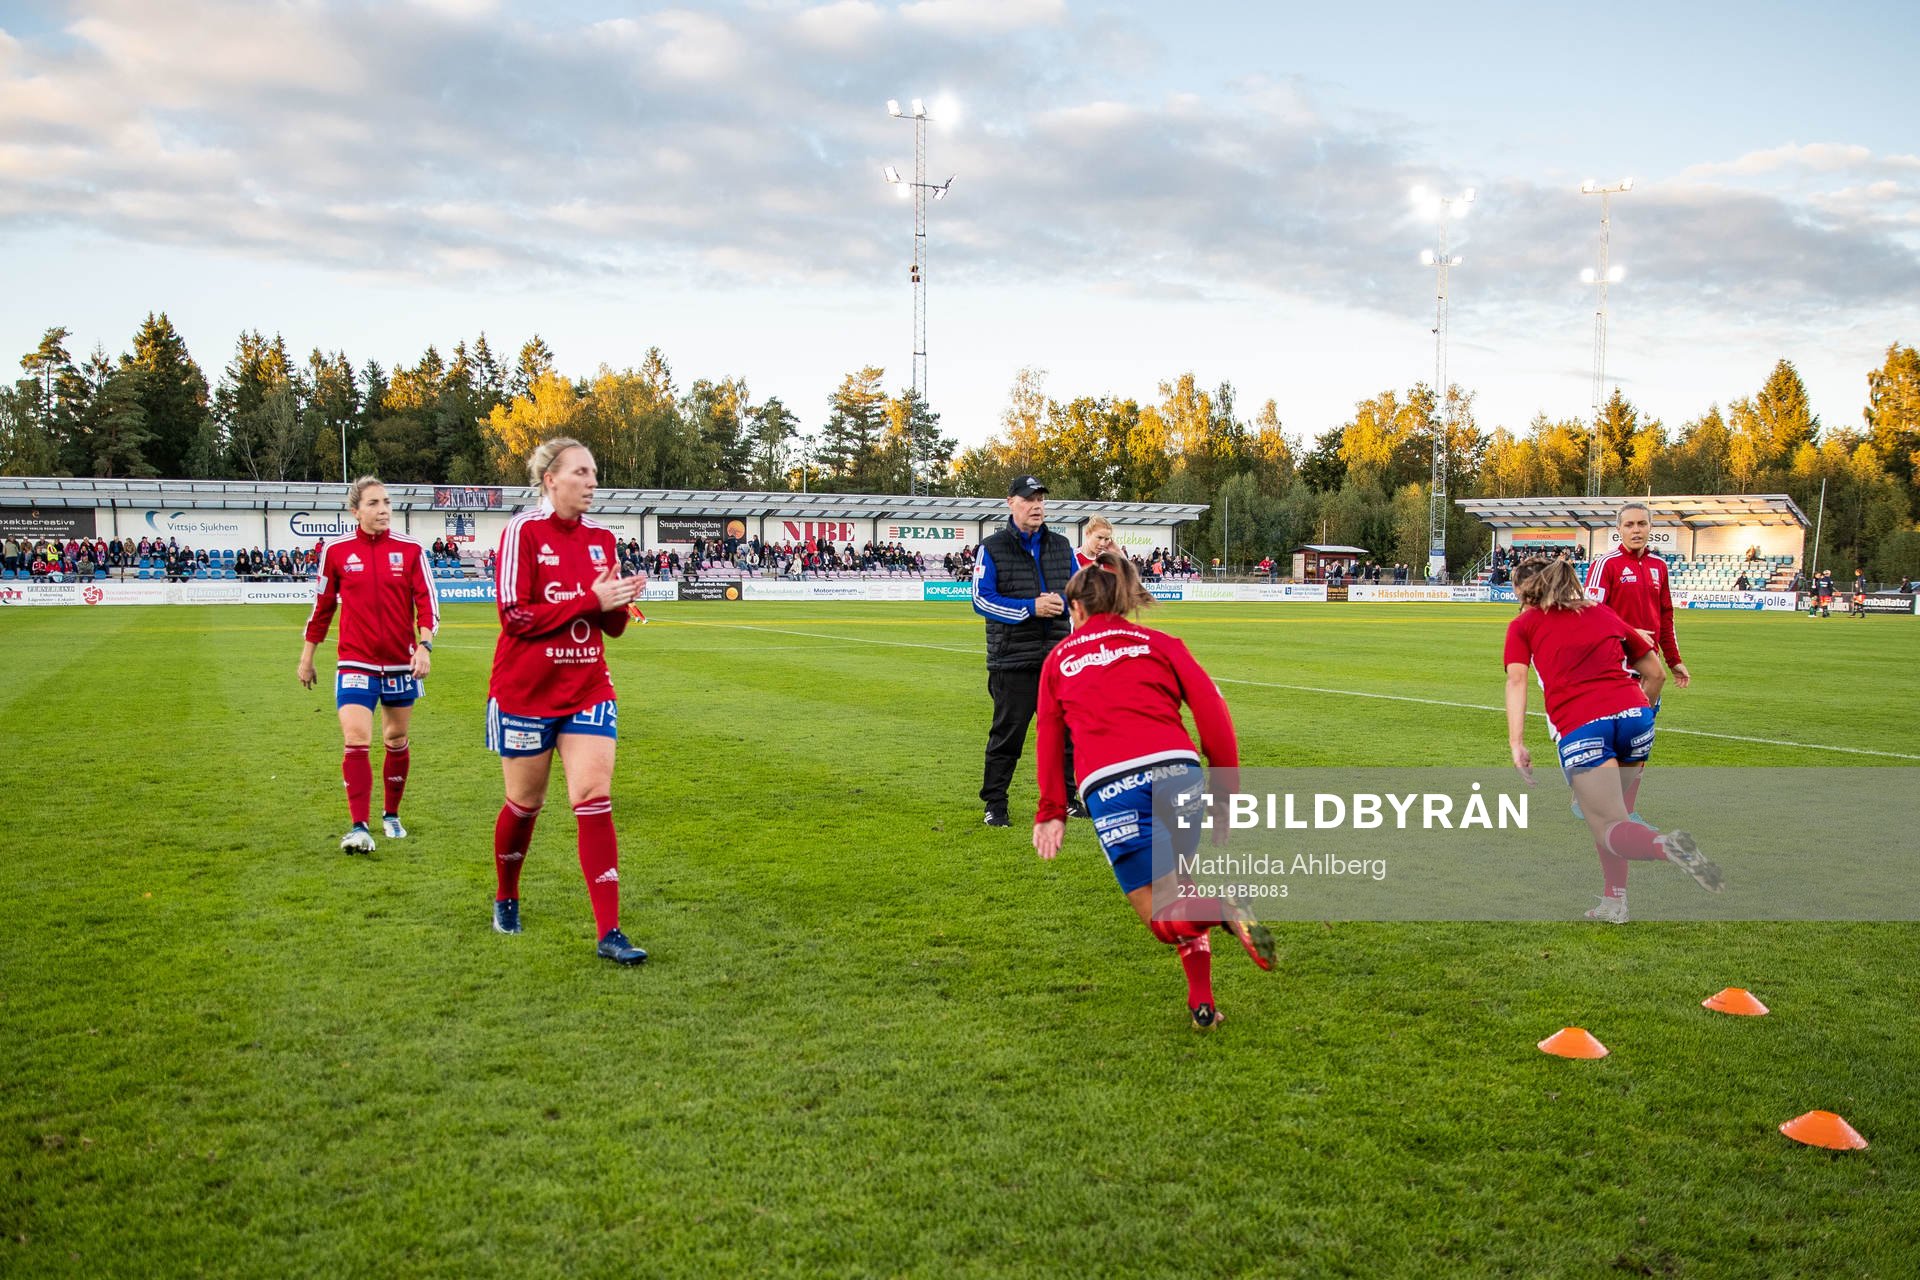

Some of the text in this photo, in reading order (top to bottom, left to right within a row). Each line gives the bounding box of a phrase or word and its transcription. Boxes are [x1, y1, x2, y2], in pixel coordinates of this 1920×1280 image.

[200, 522, 239, 533] Sjukhem
[290, 512, 357, 536] Emmalju
[659, 520, 721, 531] Snapphanebygdens
[689, 529, 721, 538] Sparbank
[783, 521, 856, 542] NIBE
[898, 526, 956, 540] PEAB
[440, 586, 485, 598] svensk
[926, 587, 972, 595] KONECRANE
[1692, 593, 1740, 602] AKADEMIEN
[1863, 599, 1912, 607] mballator
